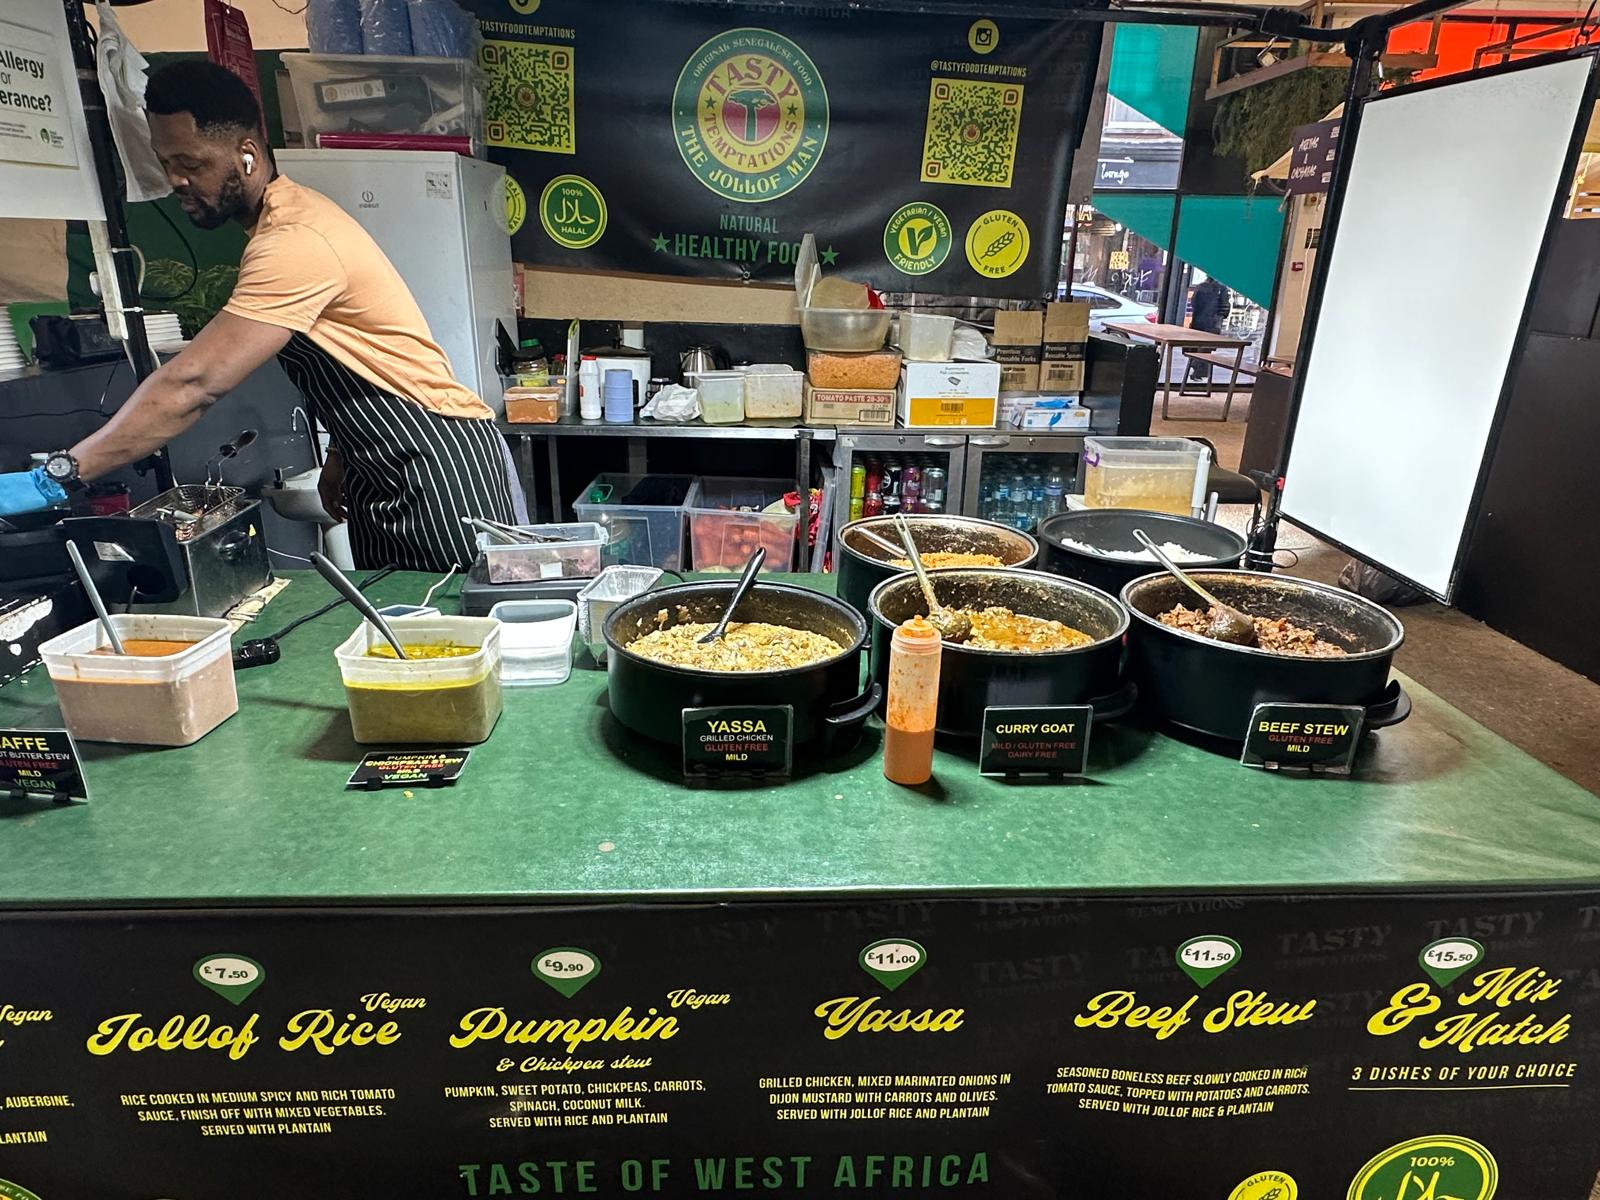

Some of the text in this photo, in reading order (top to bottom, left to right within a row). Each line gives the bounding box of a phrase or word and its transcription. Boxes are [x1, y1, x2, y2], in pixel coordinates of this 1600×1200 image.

[693, 37, 812, 86] ORIGINAL SENEGALESE FOOD
[931, 60, 1027, 78] @TASTYFOODTEMPTATIONS
[704, 57, 799, 99] TASTY
[704, 112, 799, 168] TEMPTATIONS
[681, 124, 820, 194] THE JOLLOF MAN
[561, 188, 584, 197] 100%
[553, 196, 596, 225] حلال
[719, 214, 780, 235] NATURAL
[889, 207, 948, 238] VEGETARIAN VEGAN
[983, 215, 1019, 229] GLUTEN
[561, 226, 588, 235] HALAL
[674, 234, 802, 265] HEALTHY FOO
[893, 252, 936, 271] FRIENDLY
[983, 264, 1006, 274] FREE
[816, 394, 844, 402] TOMATO
[844, 394, 866, 402] PASTE
[707, 720, 767, 733] YASSA
[995, 724, 1076, 734] CURRY GOAT
[1258, 721, 1350, 736] BEEF STEW
[0, 736, 50, 751] AFFE
[992, 742, 1012, 750] MILD
[1268, 734, 1334, 744] GLUTEN FREE
[704, 743, 769, 752] GLUTEN FREE
[1007, 751, 1034, 759] DAIRY
[1286, 744, 1310, 753] MILD
[8, 751, 43, 760] BUTTER
[725, 753, 748, 761] MILD
[18, 769, 42, 777] MILD
[13, 778, 56, 789] VEGAN
[868, 951, 916, 965] £11.00
[1185, 947, 1231, 962] £11.50
[1428, 950, 1473, 963] £15.50
[203, 965, 249, 980] £7.50
[544, 959, 584, 973] £9.90
[1457, 966, 1563, 1008] Mix
[360, 992, 427, 1014] Vegan
[666, 988, 731, 1010] Vegan
[1074, 989, 1318, 1040] Beef Stew
[1366, 983, 1442, 1036] &
[814, 996, 965, 1040] Yassa
[86, 1008, 403, 1060] Jollof Rice
[449, 1005, 680, 1054] Pumpkin
[1418, 1012, 1573, 1053] Match
[496, 1054, 653, 1075] & Chickpea stew
[1351, 1063, 1578, 1081] 3 DISHES OF YOUR CHOICE
[759, 1073, 1011, 1089] GRILLED CHICKEN, MIXED MARINATED ONIONS IN
[1056, 1066, 1308, 1086] SEASONED BONELESS BEEF SLOWLY COOKED IN RICH
[444, 1079, 706, 1098] PUMPKIN, SWEET POTATO, CHICKPEAS, CARROTS,
[1046, 1083, 1311, 1102] TOMATO SAUCE, TOPPED WITH POTATOES AND CARROTS.
[5, 1095, 75, 1108] AUBERGINE,
[120, 1088, 396, 1106] RICE COOKED IN MEDIUM SPICY AND RICH TOMATO
[769, 1090, 999, 1104] DIJON MUSTARD WITH CARROTS AND OLIVES.
[509, 1098, 646, 1112] SPINACH, COCONUT MILK.
[137, 1105, 387, 1121] SAUCE, FINISH OFF WITH MIXED VEGETABLES.
[489, 1113, 668, 1128] SERVED WITH RICE AND PLANTAIN
[776, 1106, 990, 1120] SERVED WITH JOLLOF RICE AND PLANTAIN
[1410, 1156, 1456, 1167] 100%
[458, 1152, 990, 1196] TASTE OF WEST AFRICA
[1246, 1174, 1287, 1188] GLUTEN
